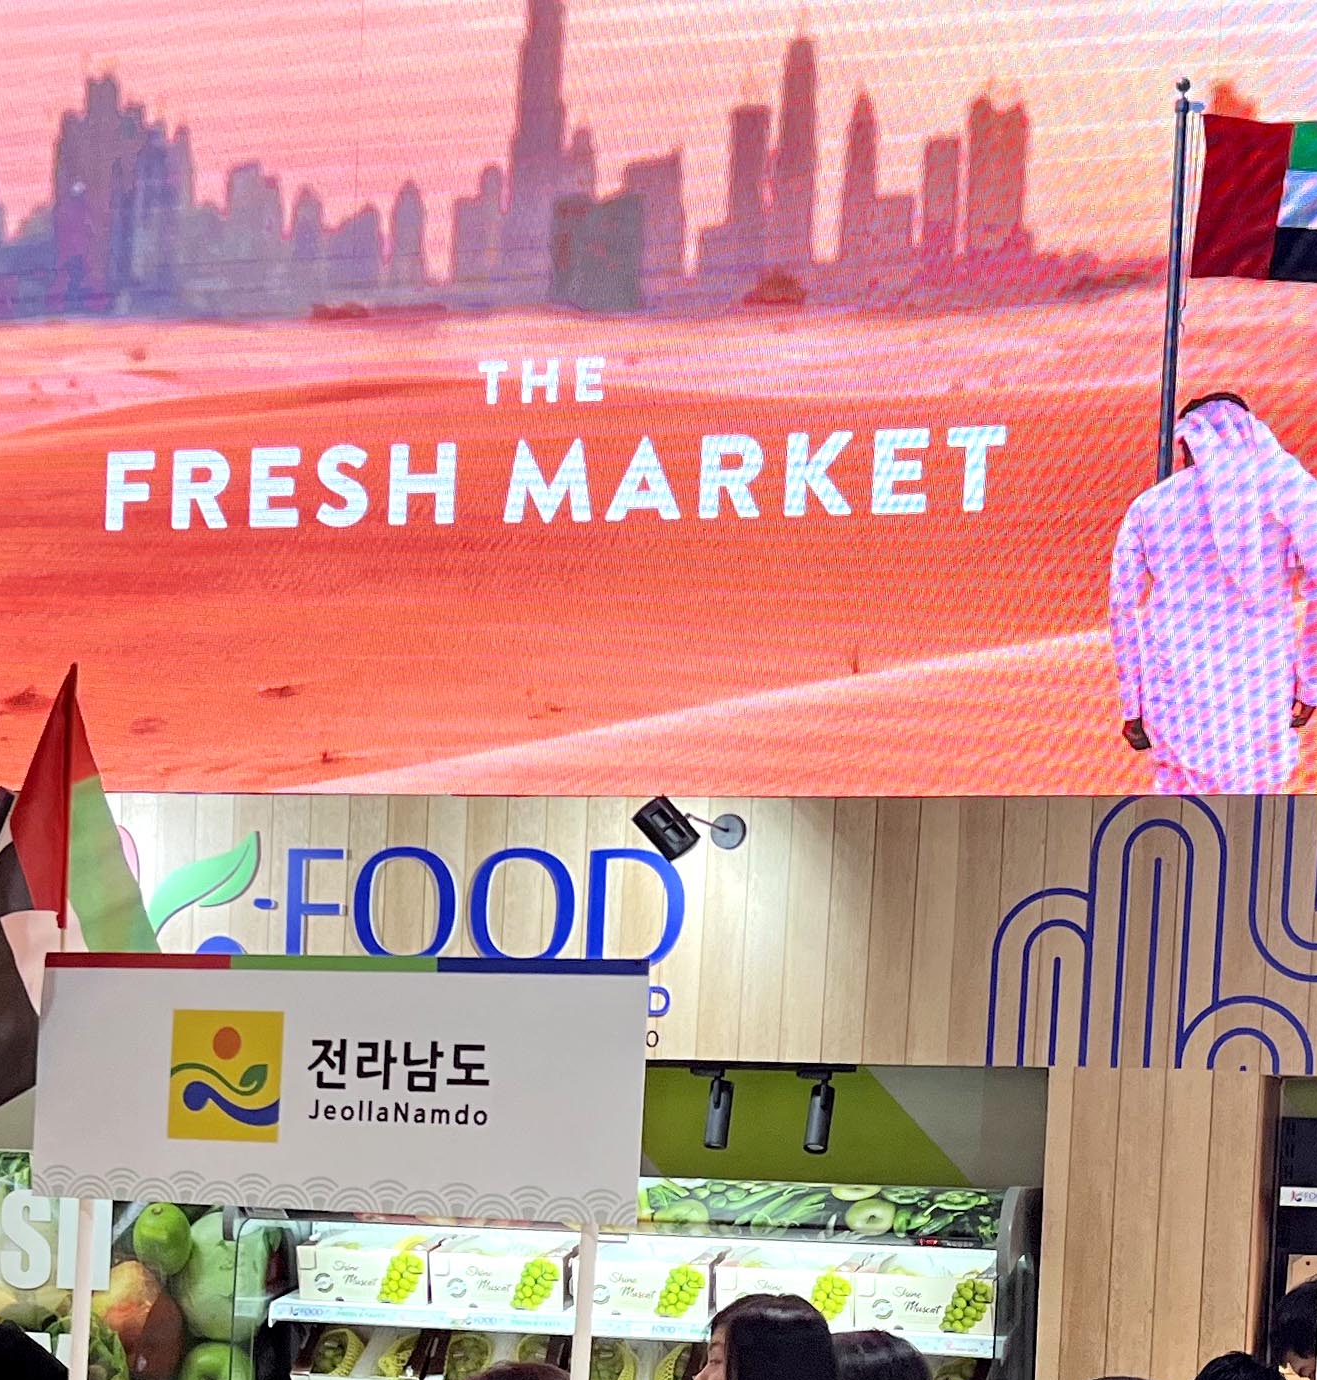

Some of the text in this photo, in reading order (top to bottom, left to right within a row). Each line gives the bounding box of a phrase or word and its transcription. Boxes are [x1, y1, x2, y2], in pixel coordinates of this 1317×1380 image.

[479, 357, 605, 404] THE
[104, 425, 1007, 532] FRESH MARKET
[307, 1038, 491, 1094] 전라남도
[308, 1098, 490, 1128] JeollaNamdo
